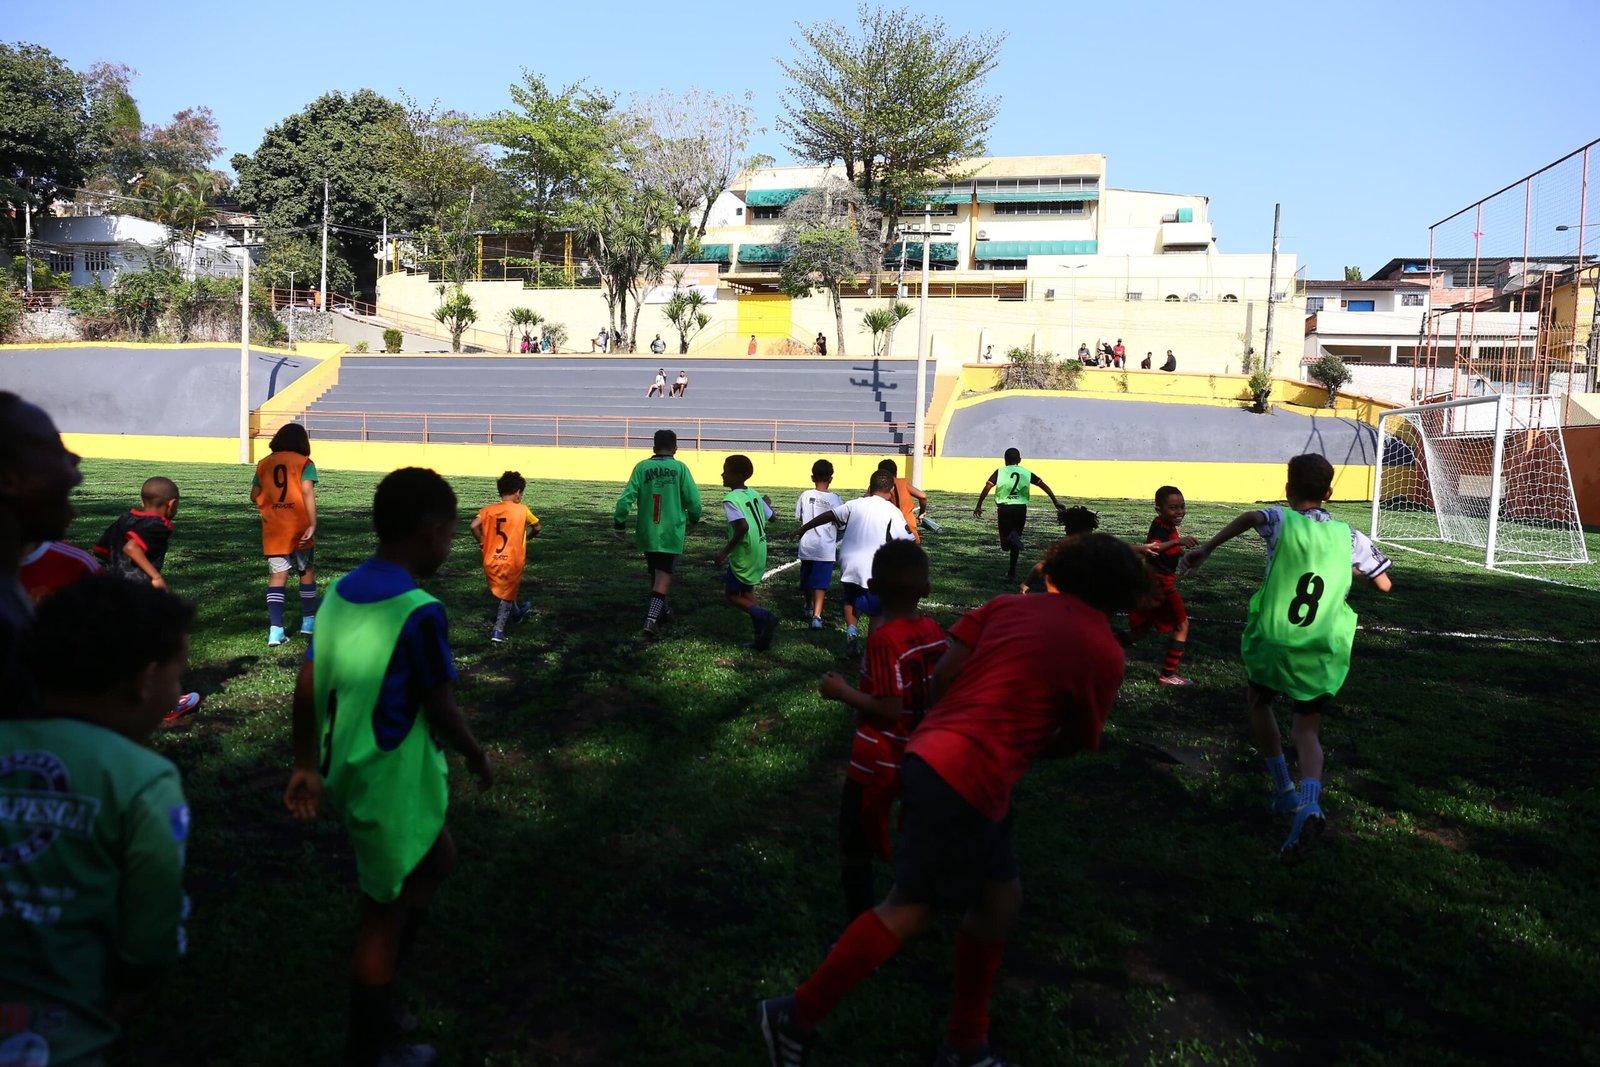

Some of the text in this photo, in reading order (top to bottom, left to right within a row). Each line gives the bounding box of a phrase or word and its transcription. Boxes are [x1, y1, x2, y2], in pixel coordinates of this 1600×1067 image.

[273, 463, 288, 502] 9
[1009, 472, 1021, 496] 2
[653, 494, 662, 524] 1
[496, 517, 508, 554] 5
[1288, 572, 1325, 627] 8
